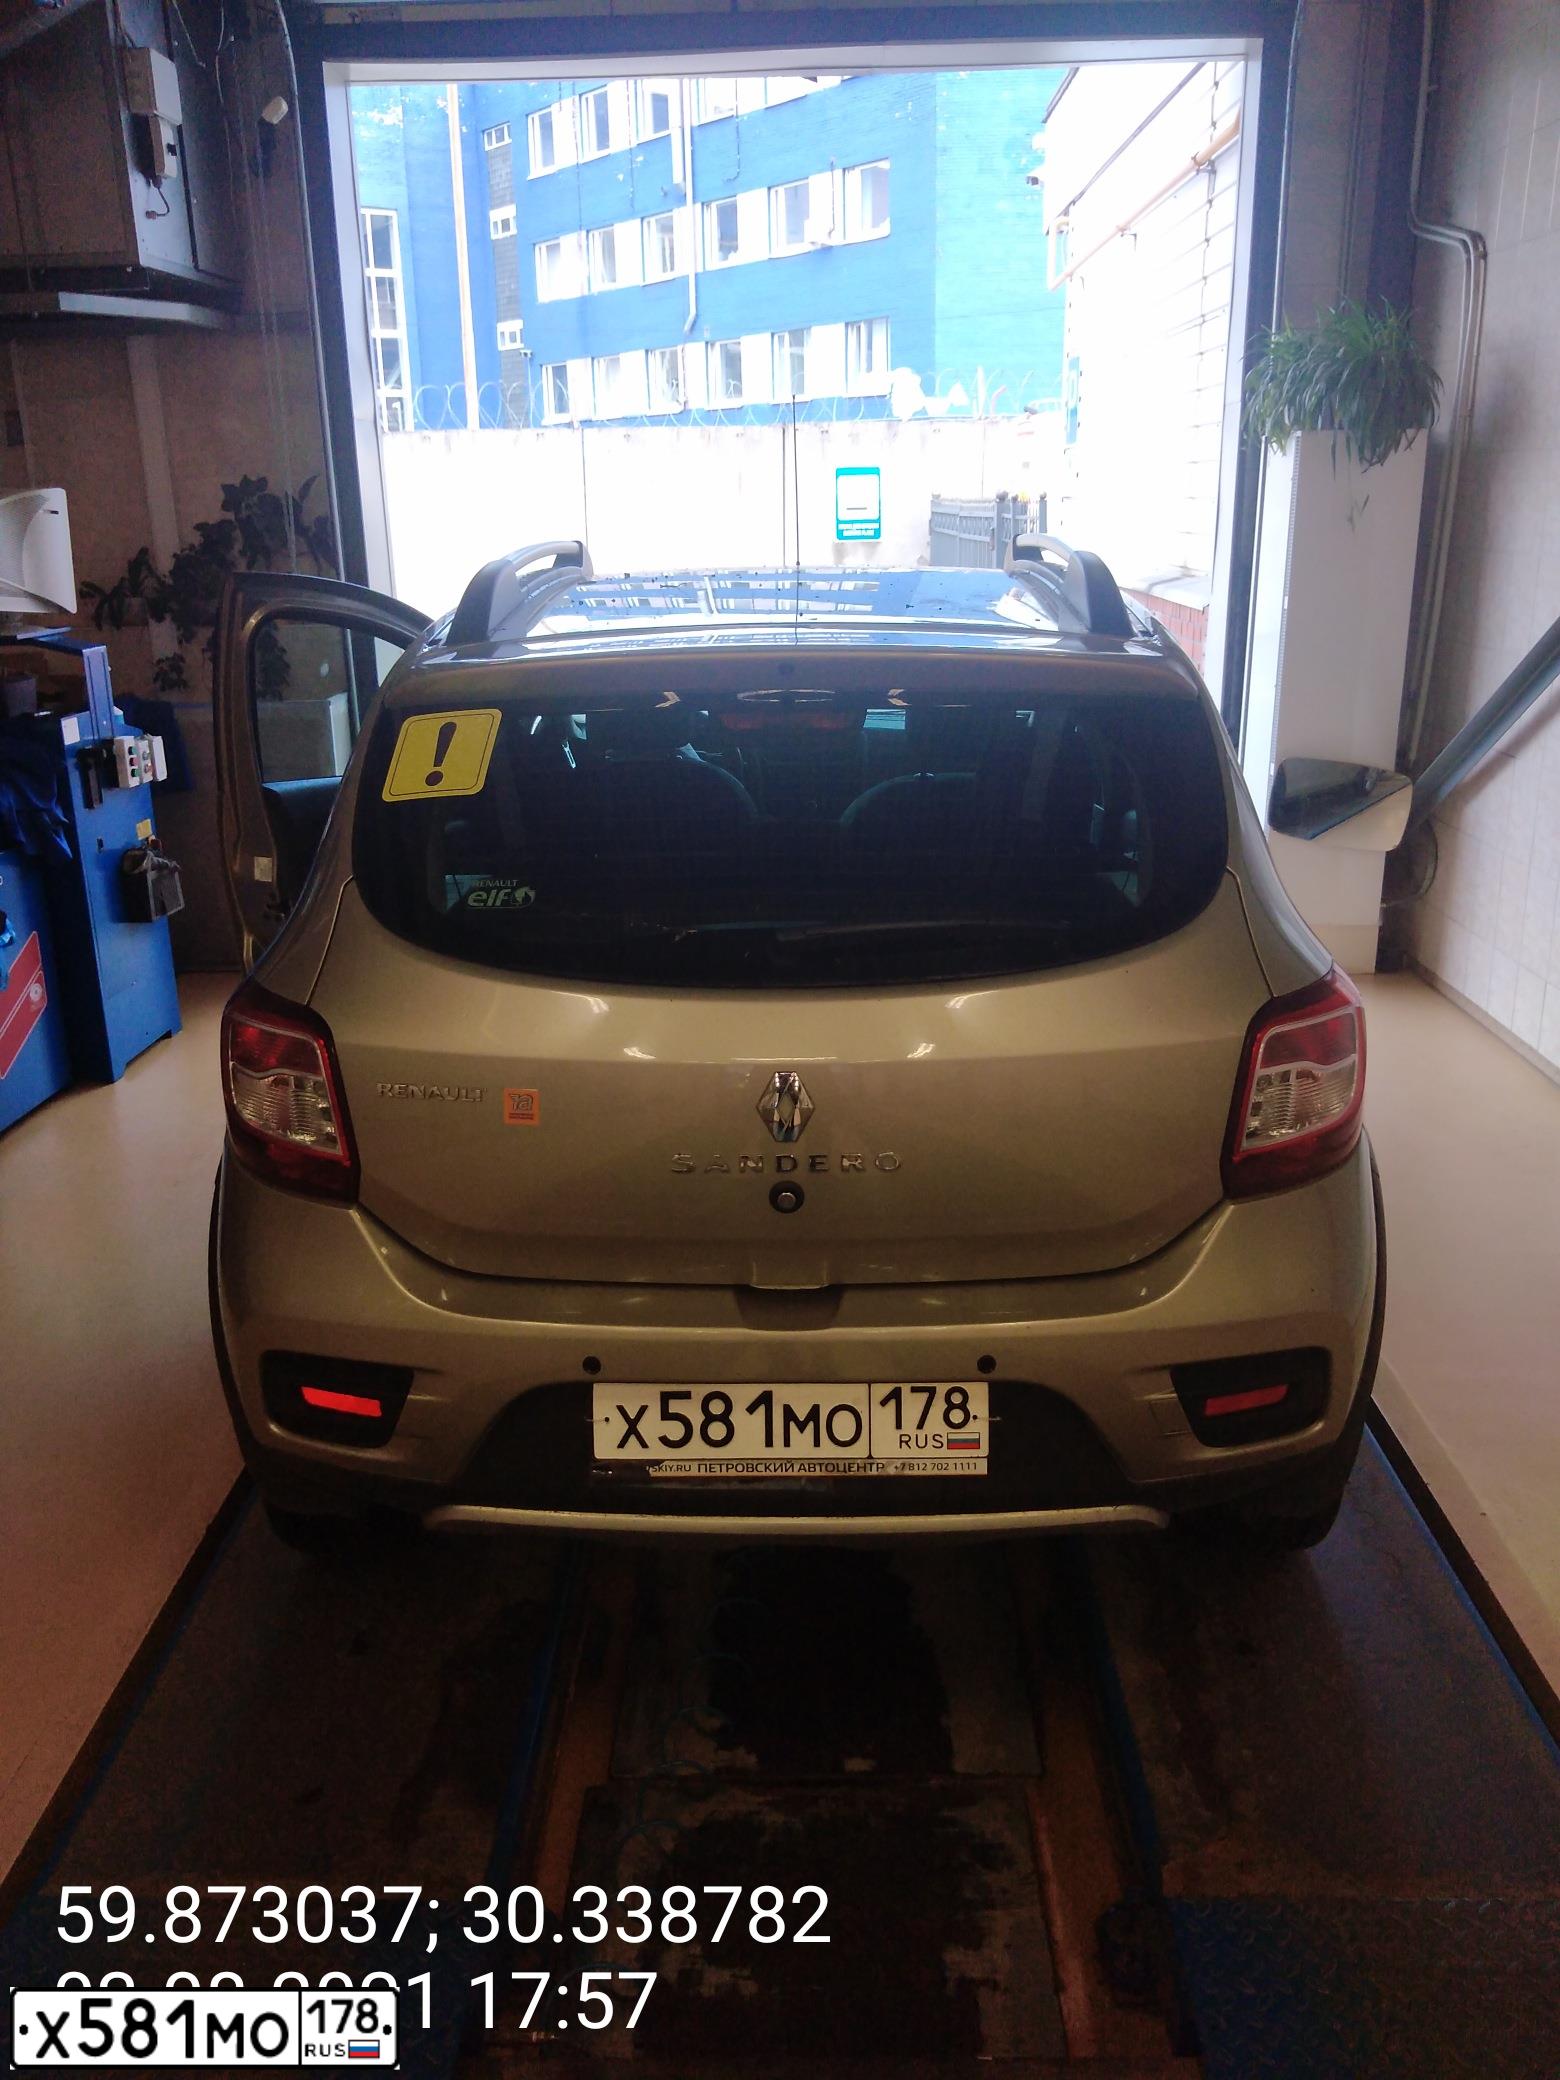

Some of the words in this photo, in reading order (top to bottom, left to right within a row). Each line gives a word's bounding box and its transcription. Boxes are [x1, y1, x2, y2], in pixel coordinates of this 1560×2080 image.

[472, 879, 518, 887] RENAULT
[467, 888, 511, 907] elf
[376, 1083, 487, 1102] RENAULT
[671, 1152, 900, 1173] SANDERO
[616, 1390, 862, 1449] Х581МО
[879, 1386, 971, 1430] 178
[899, 1433, 944, 1449] RUS
[697, 1460, 795, 1473] ПЕТРОВСКИЙ
[797, 1461, 885, 1473] АВТОЦЕНТР
[908, 1462, 928, 1472] 812
[930, 1462, 950, 1472] 702
[952, 1462, 978, 1472] 1111
